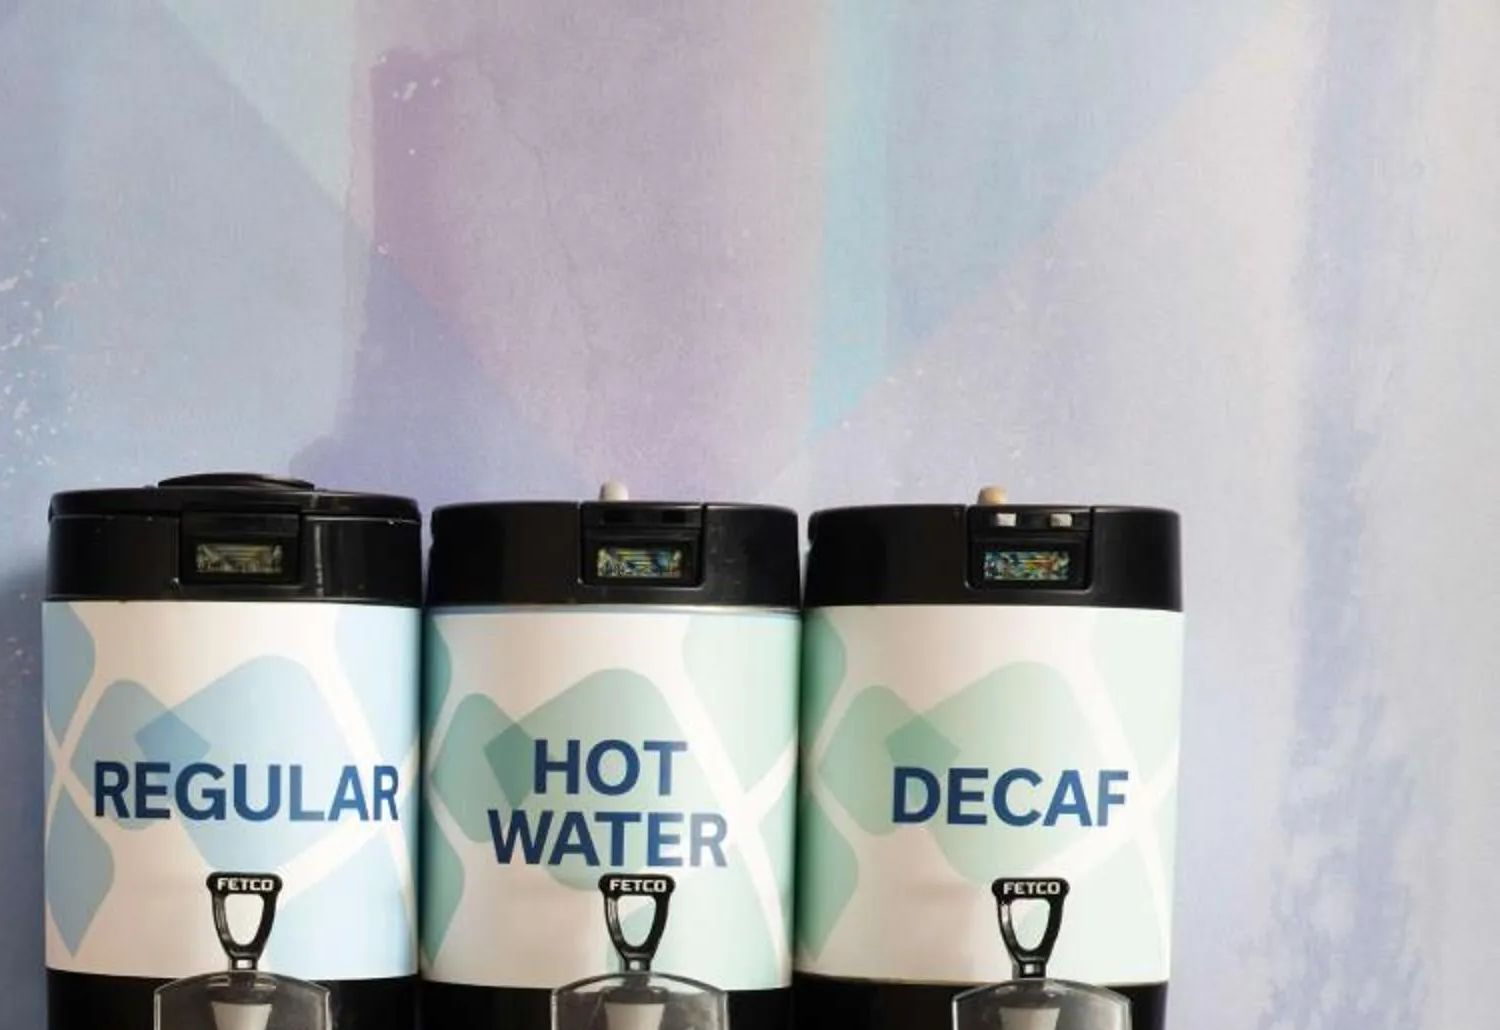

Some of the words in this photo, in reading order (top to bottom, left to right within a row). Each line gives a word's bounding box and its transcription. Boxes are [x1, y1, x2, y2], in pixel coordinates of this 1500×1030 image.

[94, 760, 400, 822] REGULAR
[533, 738, 689, 797] HOT
[892, 766, 1129, 828] DECAF
[487, 809, 729, 867] WATER
[217, 877, 275, 892] FETCO
[609, 878, 667, 893] FETCO
[1003, 881, 1061, 895] FETCO
